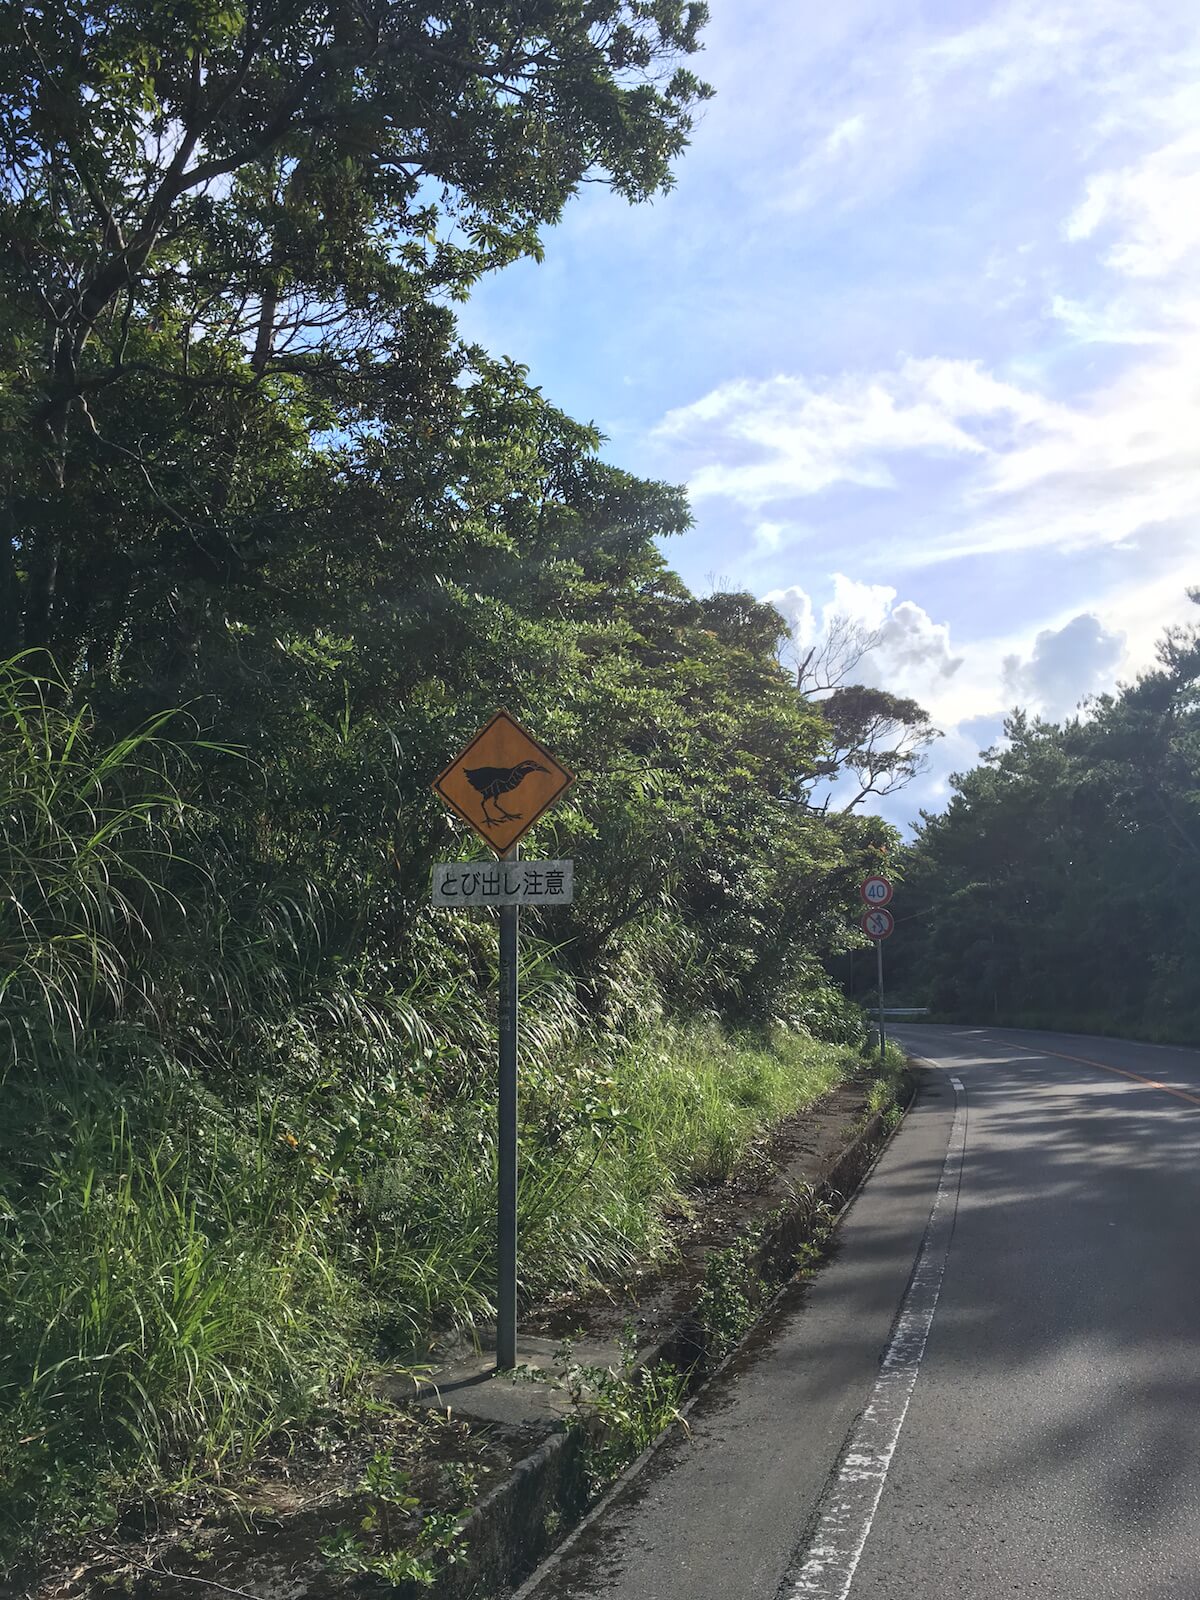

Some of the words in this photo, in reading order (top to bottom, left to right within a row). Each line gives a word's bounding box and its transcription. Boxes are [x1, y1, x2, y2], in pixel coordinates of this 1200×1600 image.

[440, 869, 565, 896] とび出し注意
[868, 884, 885, 898] 40
